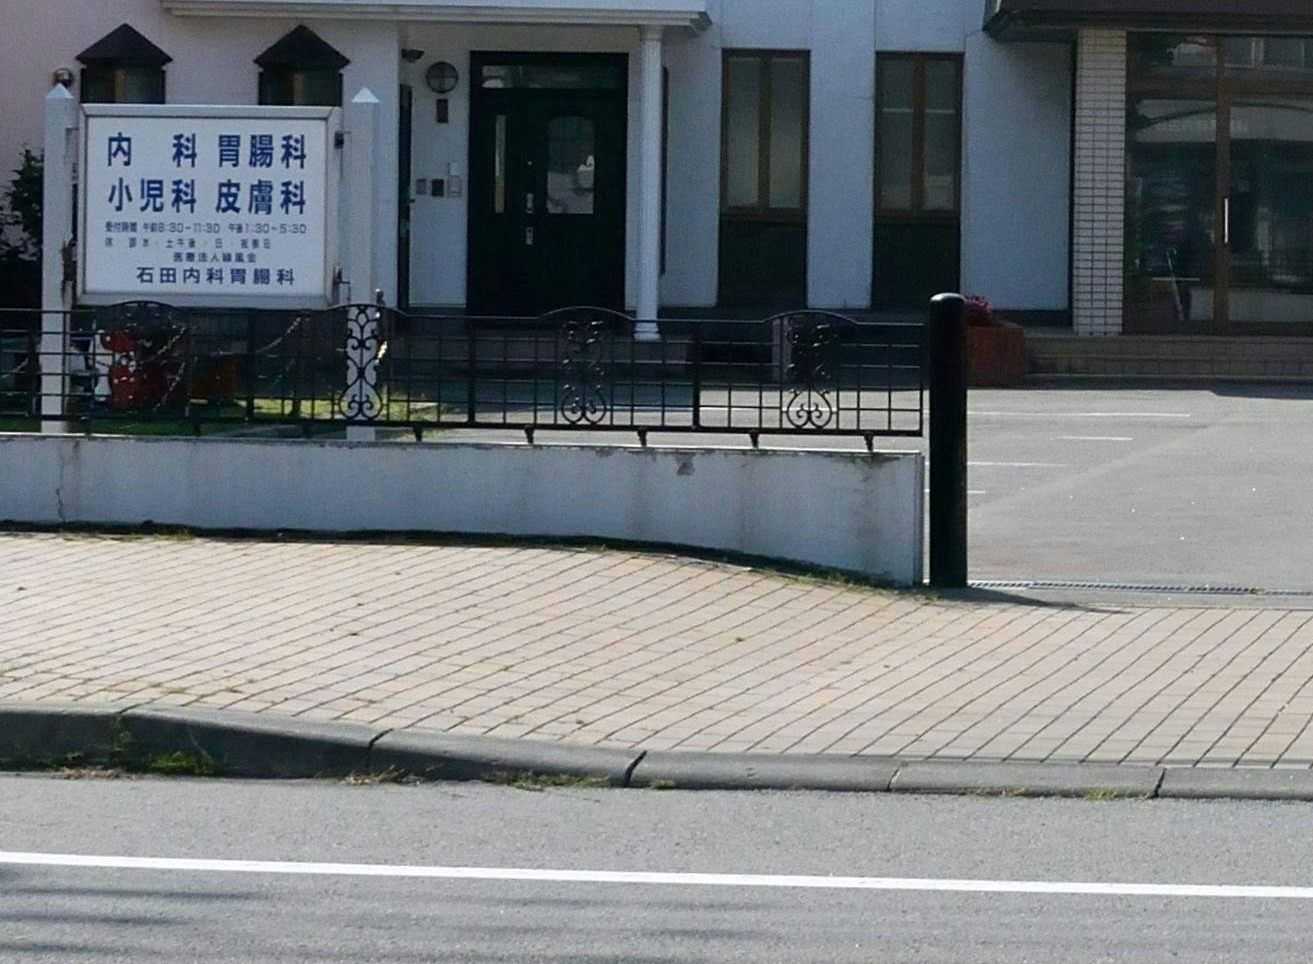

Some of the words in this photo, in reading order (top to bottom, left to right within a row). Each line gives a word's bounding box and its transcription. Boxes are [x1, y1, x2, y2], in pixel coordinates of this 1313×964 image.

[217, 133, 307, 169] 胃腸科
[107, 178, 197, 213] 小児科
[215, 179, 306, 215] 皮膚科
[136, 267, 295, 285] 石田内科胃腸科
